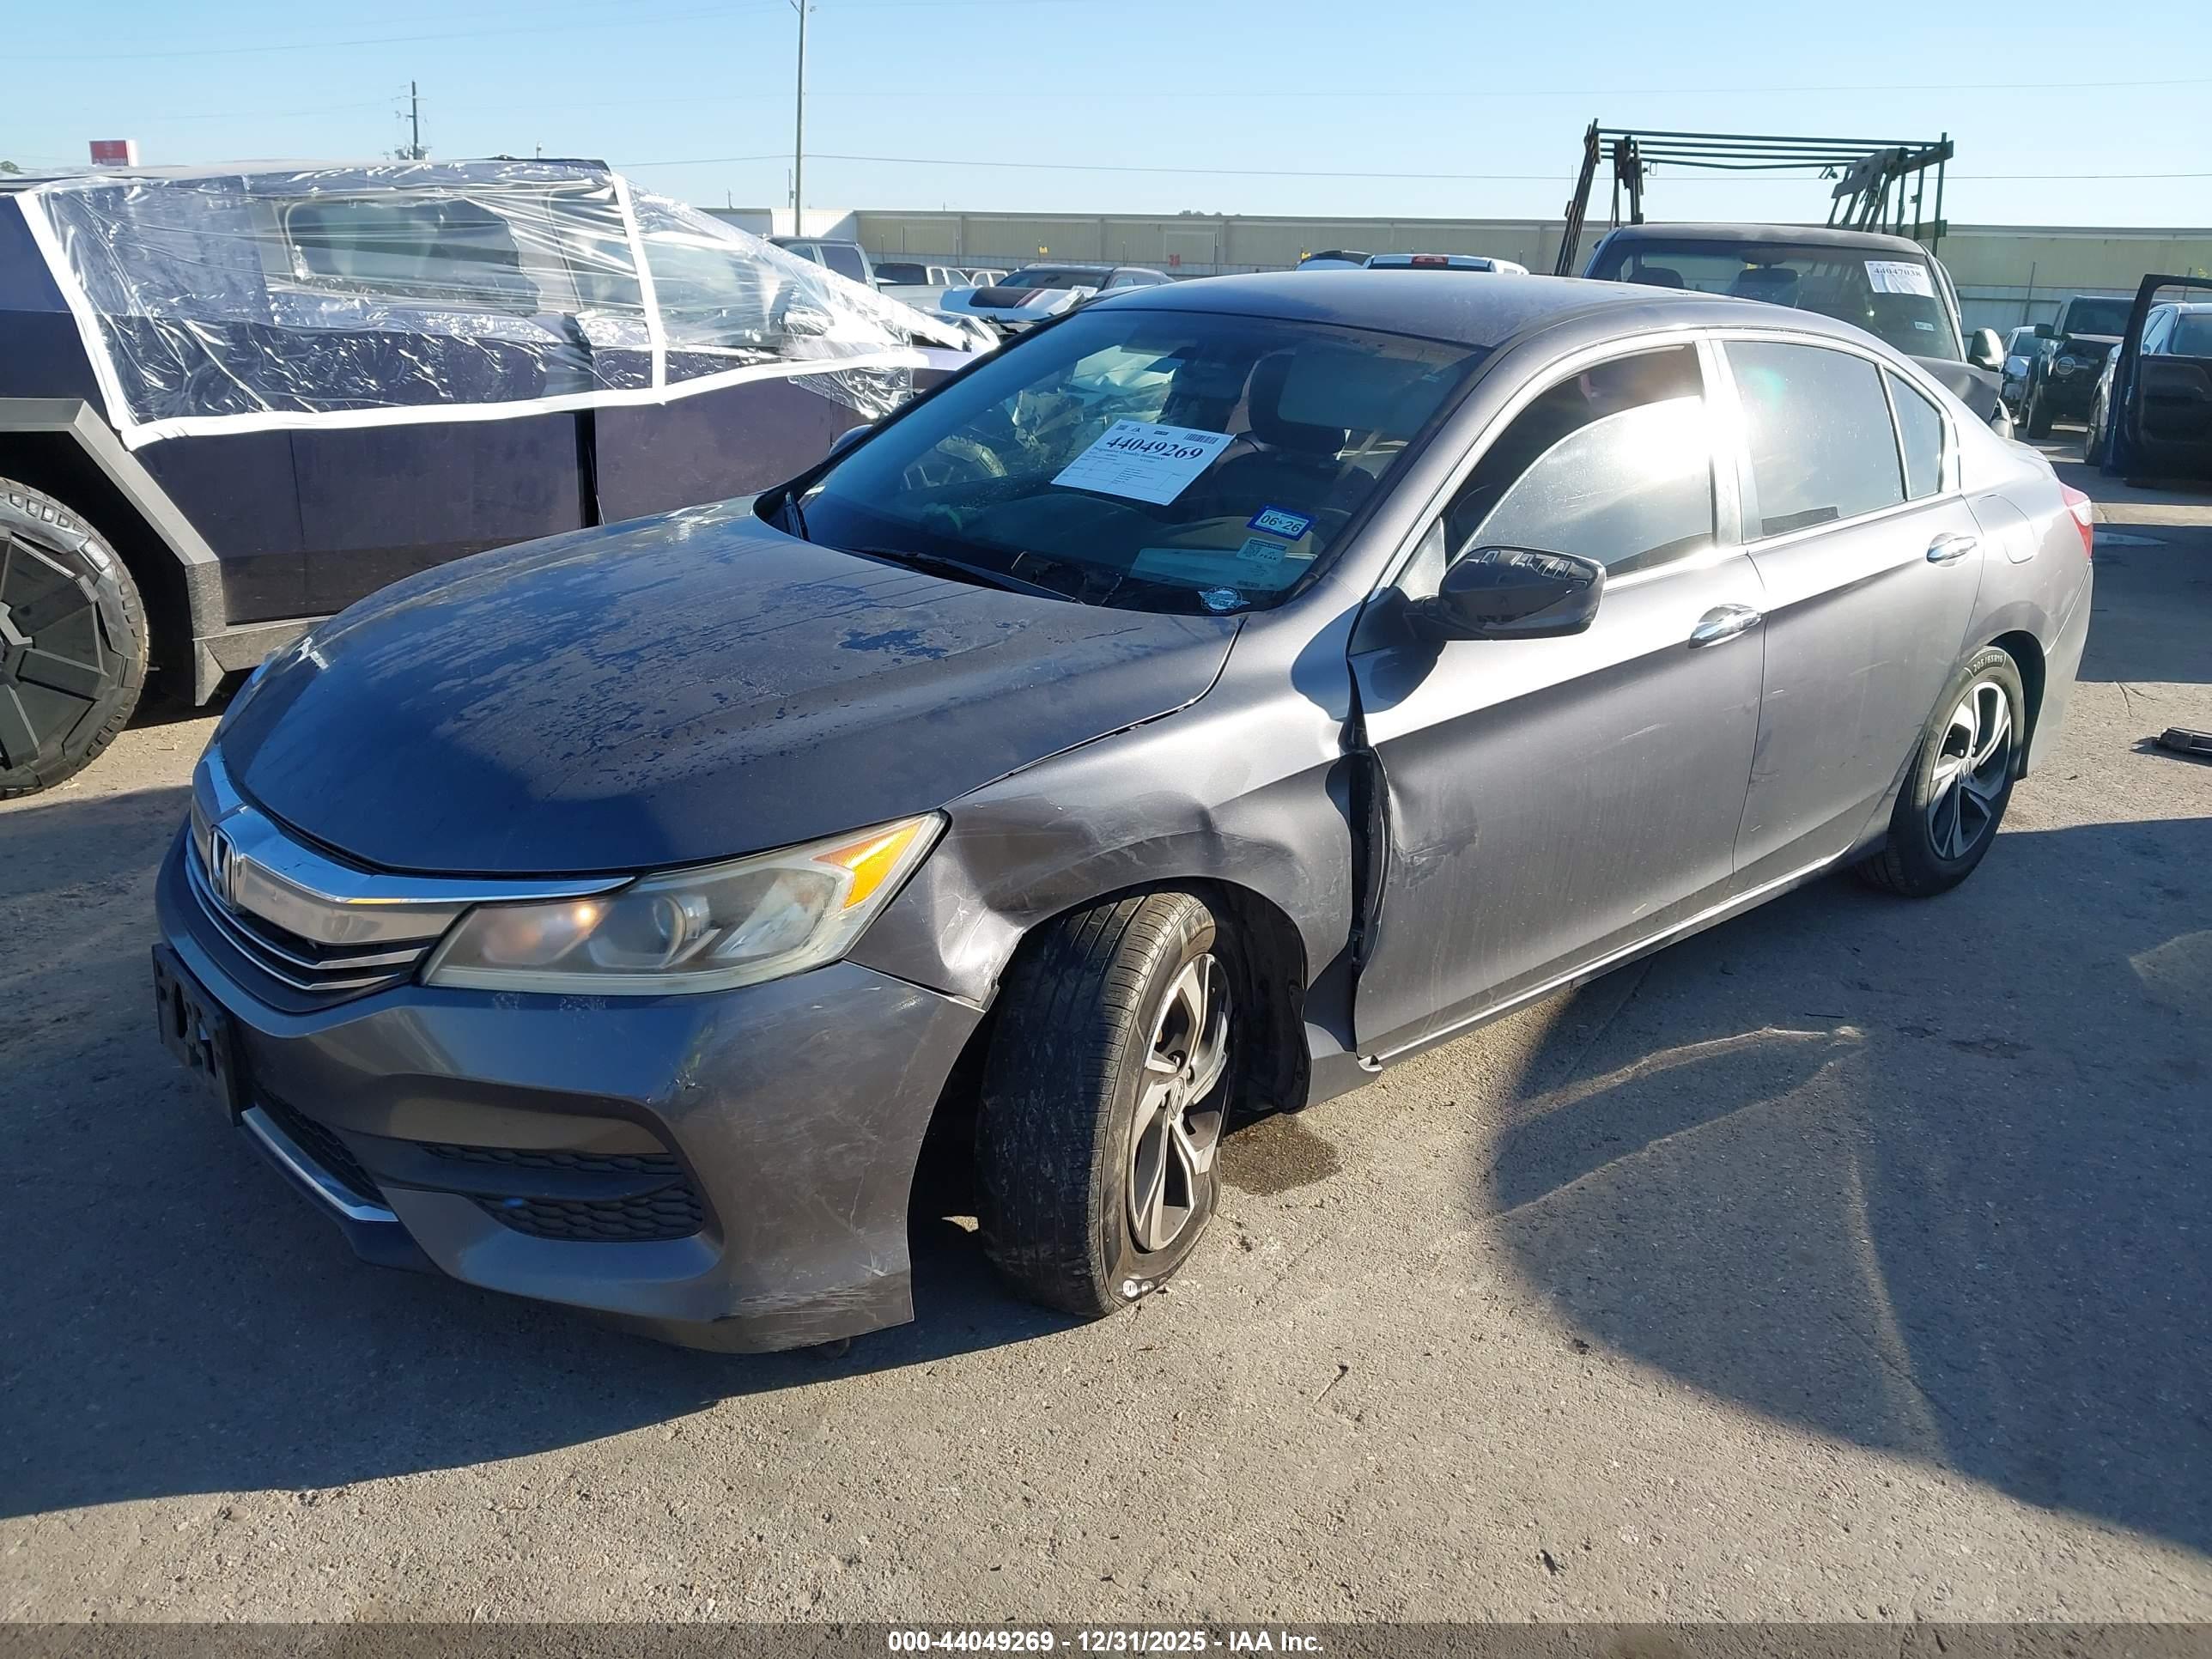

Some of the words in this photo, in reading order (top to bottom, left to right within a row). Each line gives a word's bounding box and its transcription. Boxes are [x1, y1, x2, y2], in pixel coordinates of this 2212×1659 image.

[1873, 267, 1923, 277] 44047038
[1105, 436, 1204, 460] 44049269
[1260, 514, 1279, 526] 06
[1281, 520, 1303, 532] 26
